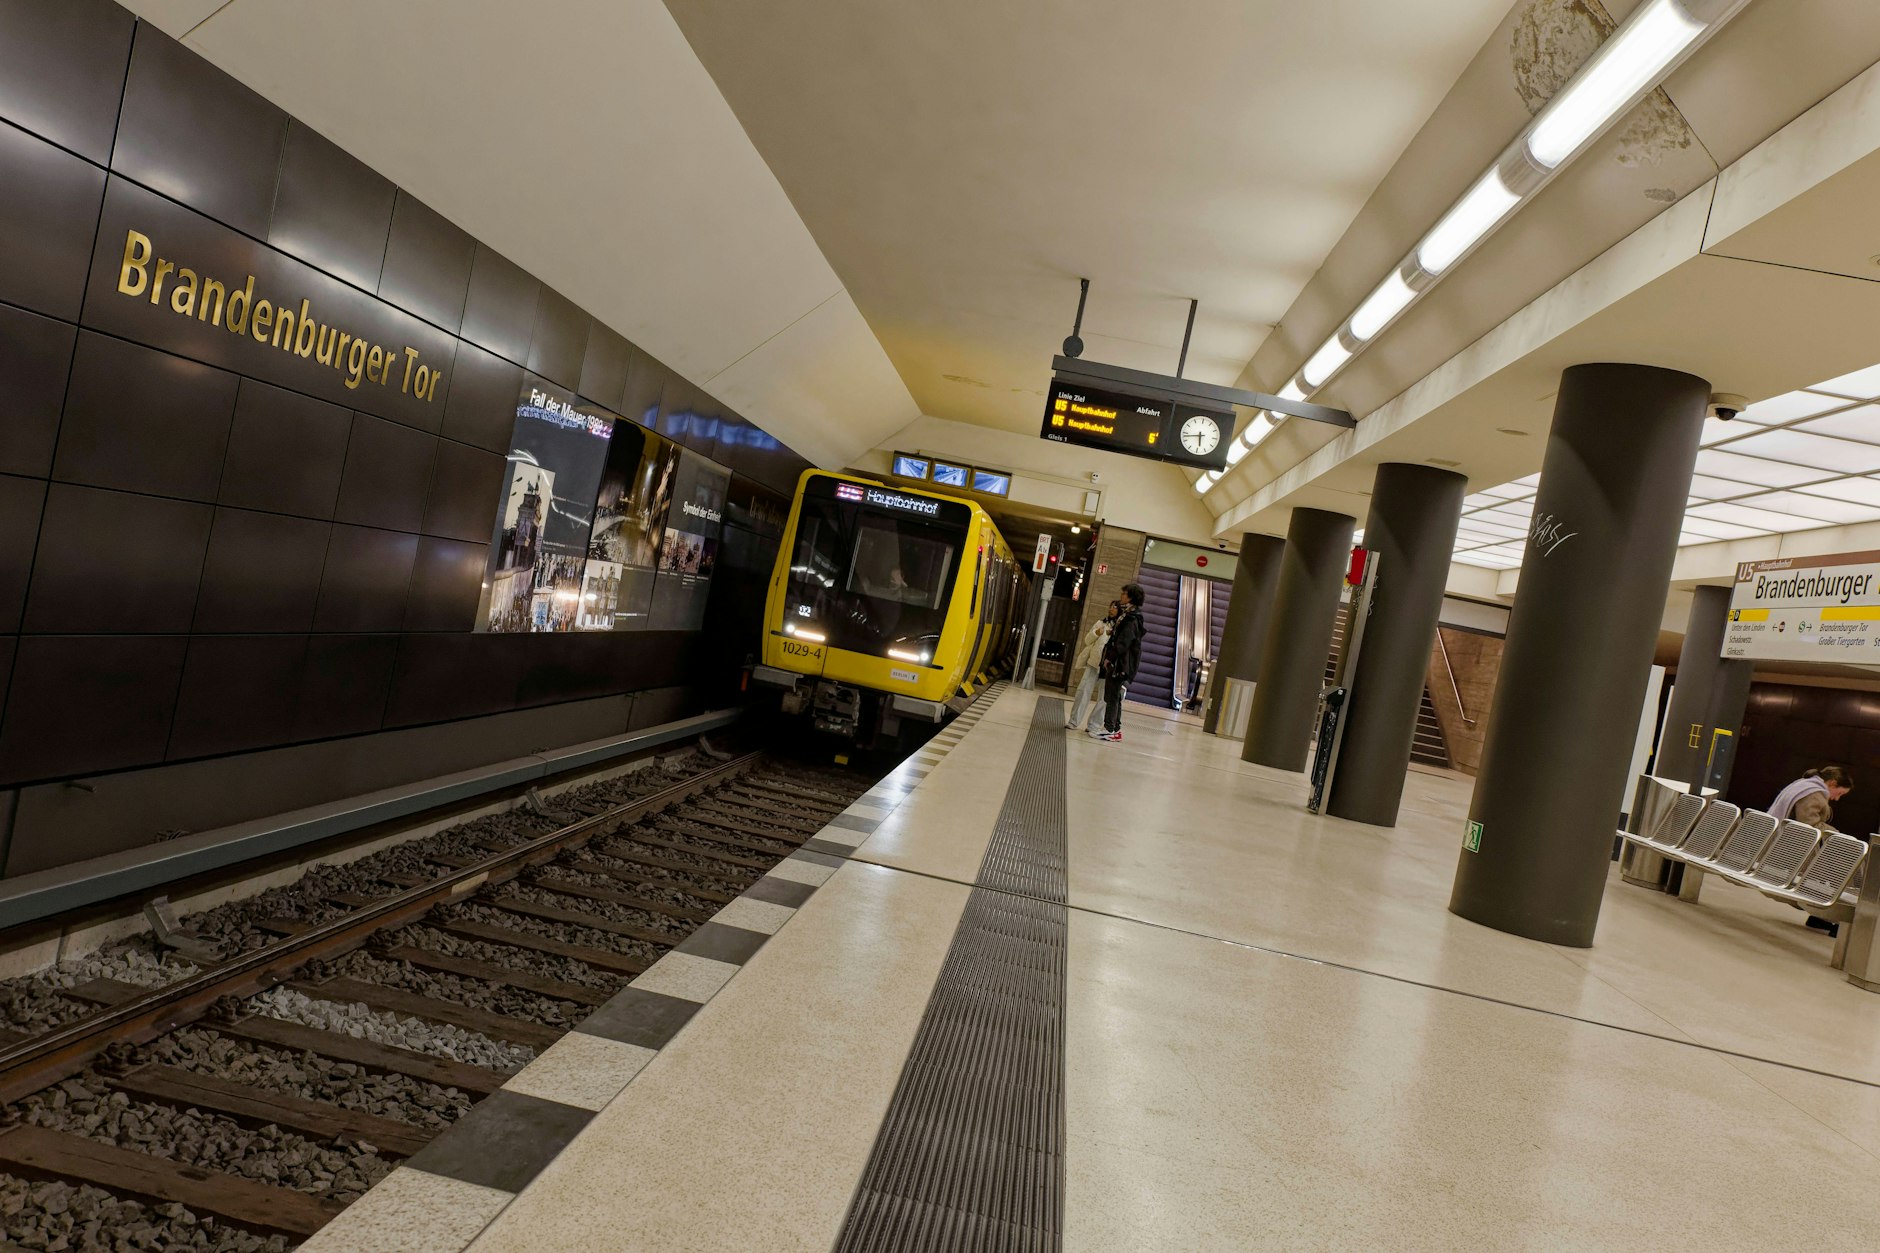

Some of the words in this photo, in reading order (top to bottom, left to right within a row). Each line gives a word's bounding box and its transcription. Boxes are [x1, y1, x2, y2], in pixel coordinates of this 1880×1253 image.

[117, 228, 396, 391] Brandenburger
[402, 347, 442, 403] Tor
[530, 388, 546, 408] Fall
[546, 397, 560, 414] der
[560, 403, 587, 425] Mauer
[1055, 399, 1068, 412] U5
[1071, 404, 1117, 420] Hauptbahnhof
[1058, 391, 1073, 400] Linie
[1073, 394, 1085, 403] Ziel
[1136, 407, 1161, 417] Abfahrt
[1052, 414, 1065, 426] U5
[1068, 419, 1114, 435] Hauptbahnhof
[1048, 433, 1063, 442] Gleis
[683, 501, 700, 516] Symbol
[699, 507, 708, 519] der
[707, 509, 721, 523] Einheit
[867, 489, 939, 515] Hauptbahnhof
[1739, 562, 1755, 581] U5
[1755, 569, 1873, 604] Brandenburger
[1819, 623, 1858, 634] Brandenburger
[1858, 622, 1869, 632] Tor
[781, 641, 822, 660] 1029-4
[1819, 636, 1836, 646] Großer
[1836, 636, 1866, 648] Tiergarten
